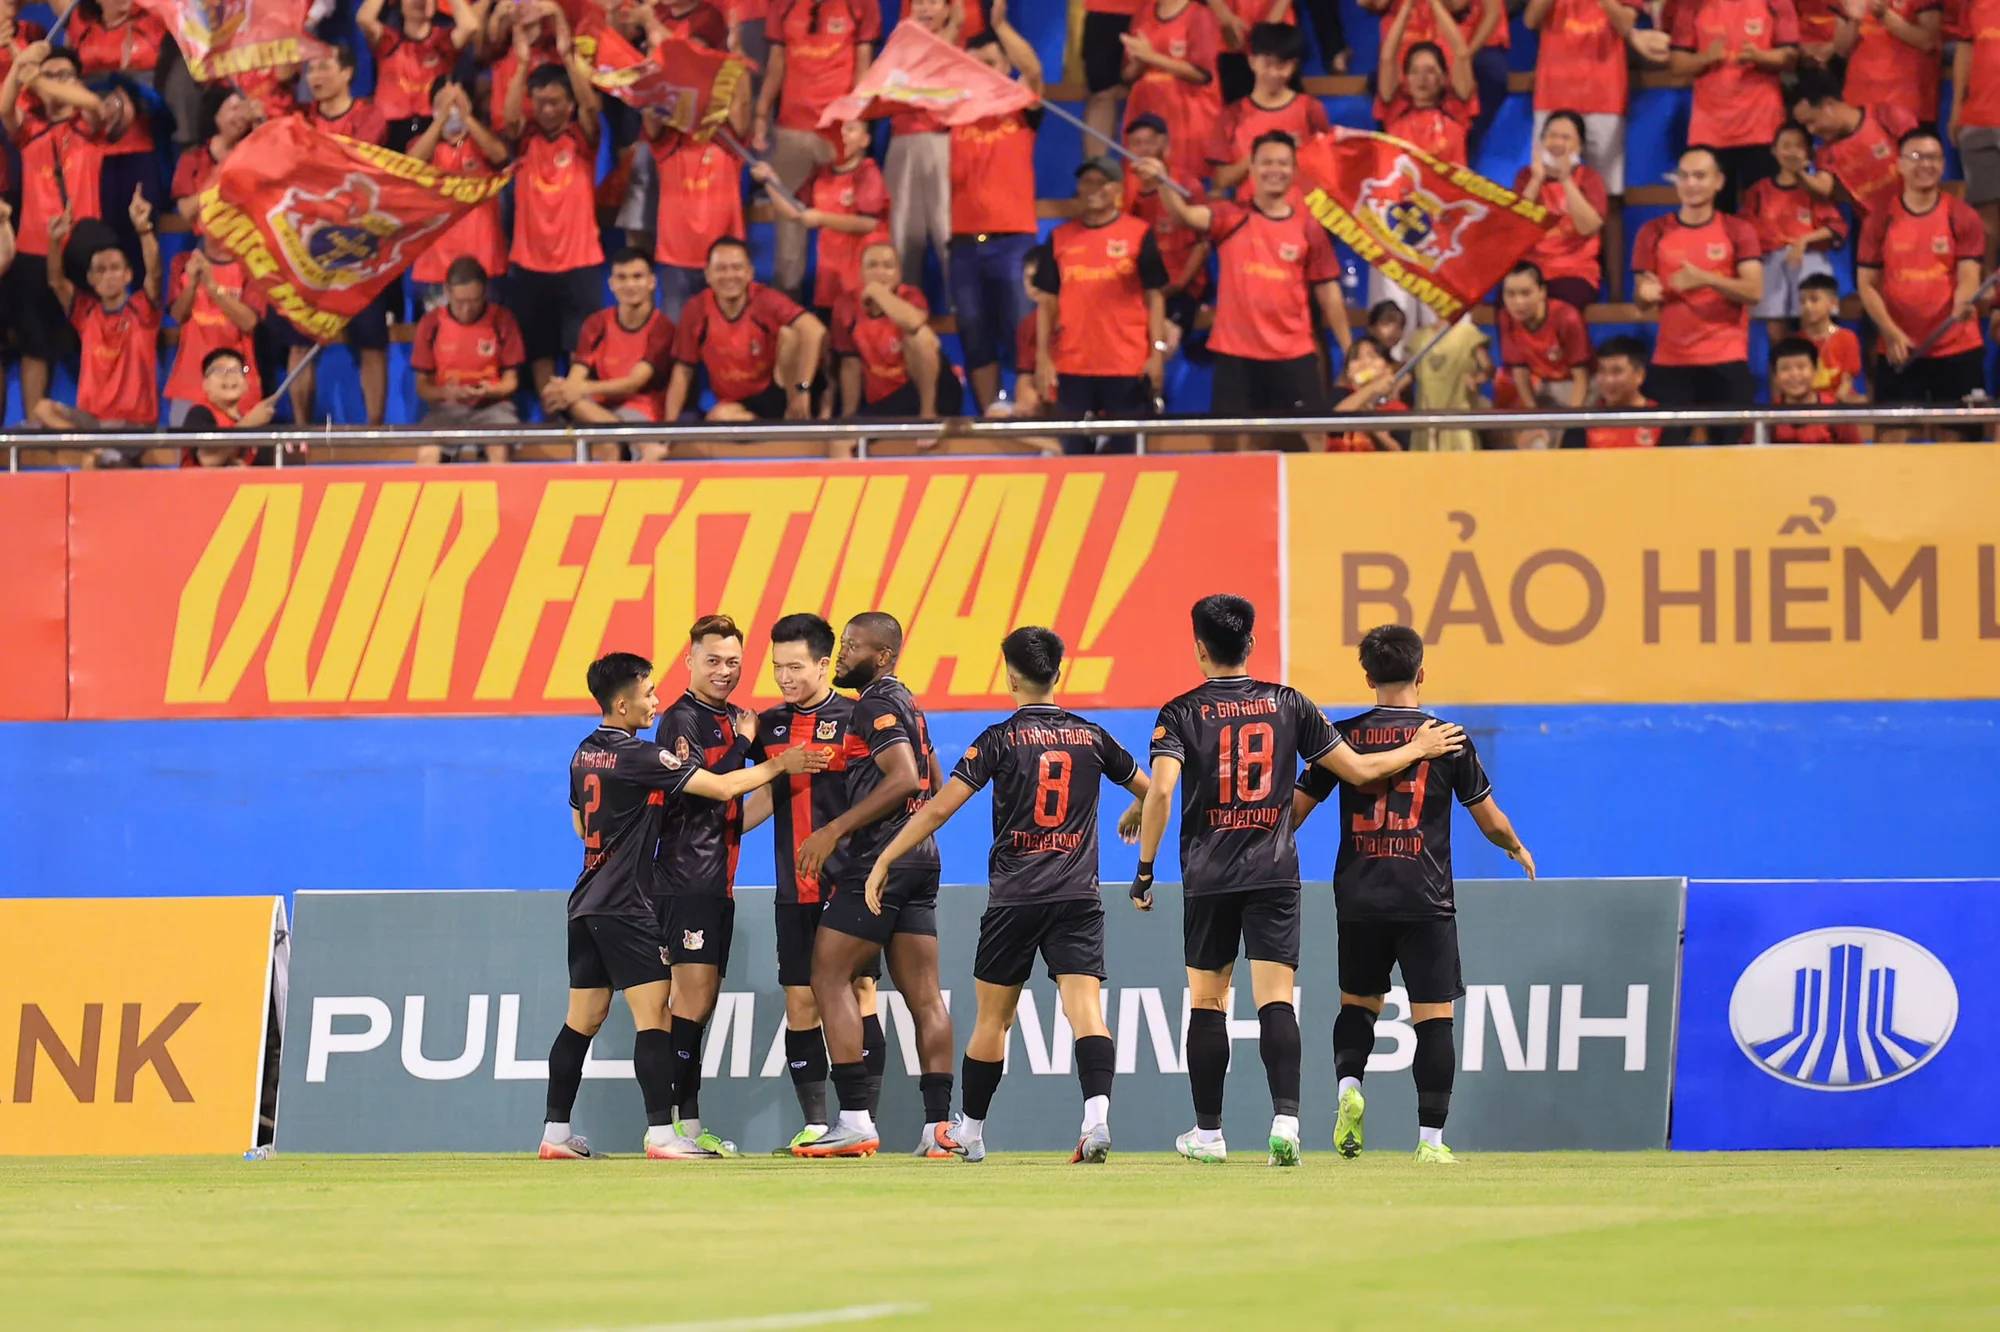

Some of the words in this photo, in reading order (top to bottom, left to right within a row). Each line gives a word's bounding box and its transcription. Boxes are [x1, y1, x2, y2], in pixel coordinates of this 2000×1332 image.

[164, 480, 500, 704] OUR
[1341, 510, 1605, 647] BẢO
[1642, 495, 1940, 645] HIỂM
[1058, 728, 1093, 746] TRUNG
[1217, 702, 1240, 718] GIA
[1033, 750, 1073, 828] 8
[1219, 722, 1274, 804] 18
[583, 773, 602, 849] 2
[1010, 830, 1081, 850] Thaigroup
[1207, 806, 1280, 827] Thaigroup
[0, 1002, 203, 1104] NK
[1364, 984, 1650, 1073] BNH
